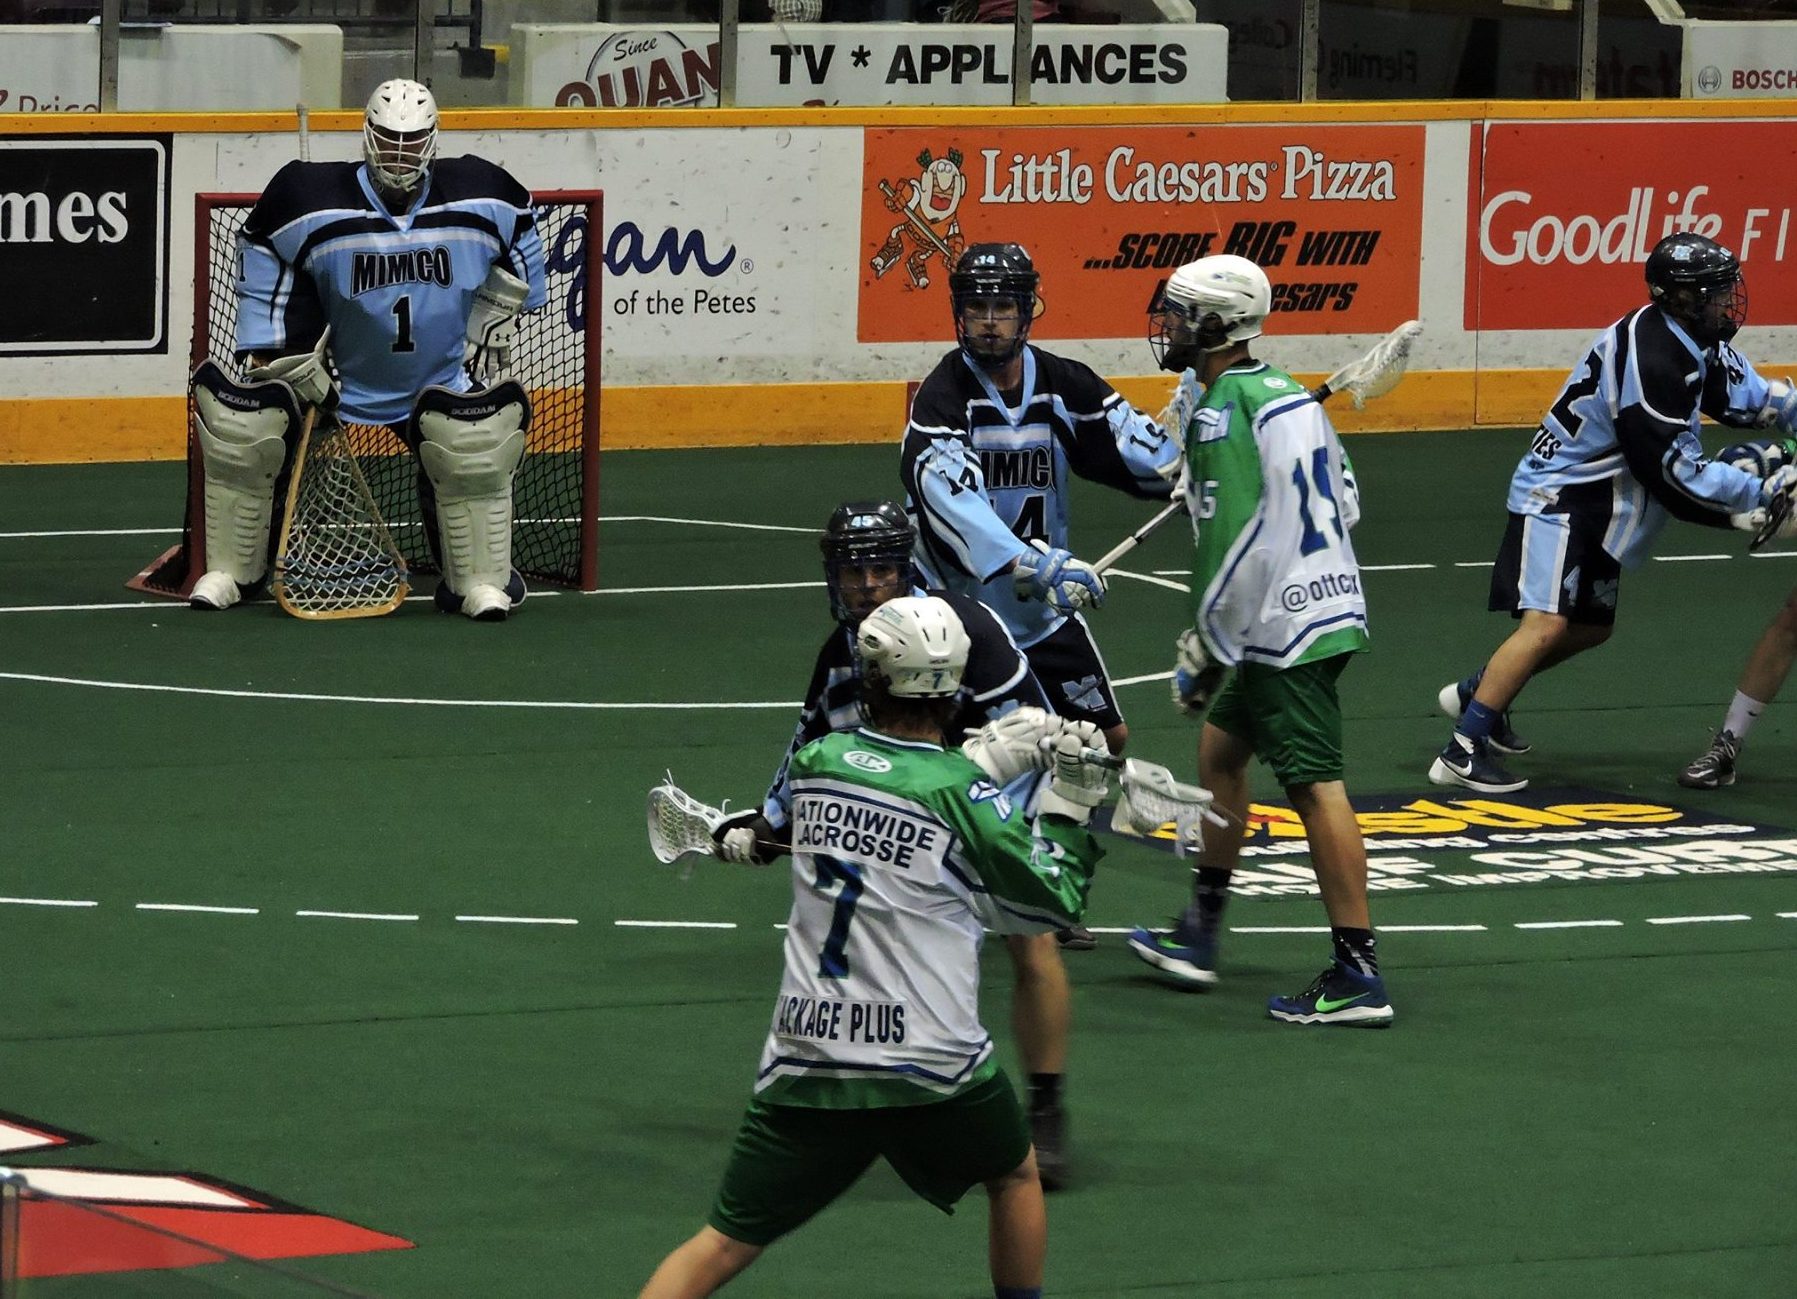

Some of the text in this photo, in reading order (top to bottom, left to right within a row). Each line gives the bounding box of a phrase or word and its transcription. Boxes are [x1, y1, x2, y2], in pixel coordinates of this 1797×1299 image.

[613, 36, 659, 61] Since
[770, 44, 836, 85] TV
[885, 43, 1188, 85] APPLANCES
[1732, 70, 1797, 89] BOSCH
[979, 145, 1397, 204] Little Caesars Pizza
[0, 191, 129, 244] mes
[1480, 185, 1723, 266] GoodLife
[1220, 220, 1297, 267] BIG
[1296, 231, 1381, 267] WITH
[351, 245, 453, 298] MIMICO
[614, 290, 756, 314] of the Petes
[1270, 283, 1358, 313] esars
[391, 295, 415, 353] 1
[976, 446, 1056, 492] IMIC
[990, 494, 1052, 550] 4
[798, 823, 915, 869] ACROSSE
[1487, 824, 1756, 843] centres
[1226, 878, 1430, 895] HOE
[813, 853, 864, 979] 7
[850, 1003, 905, 1044] PLUS
